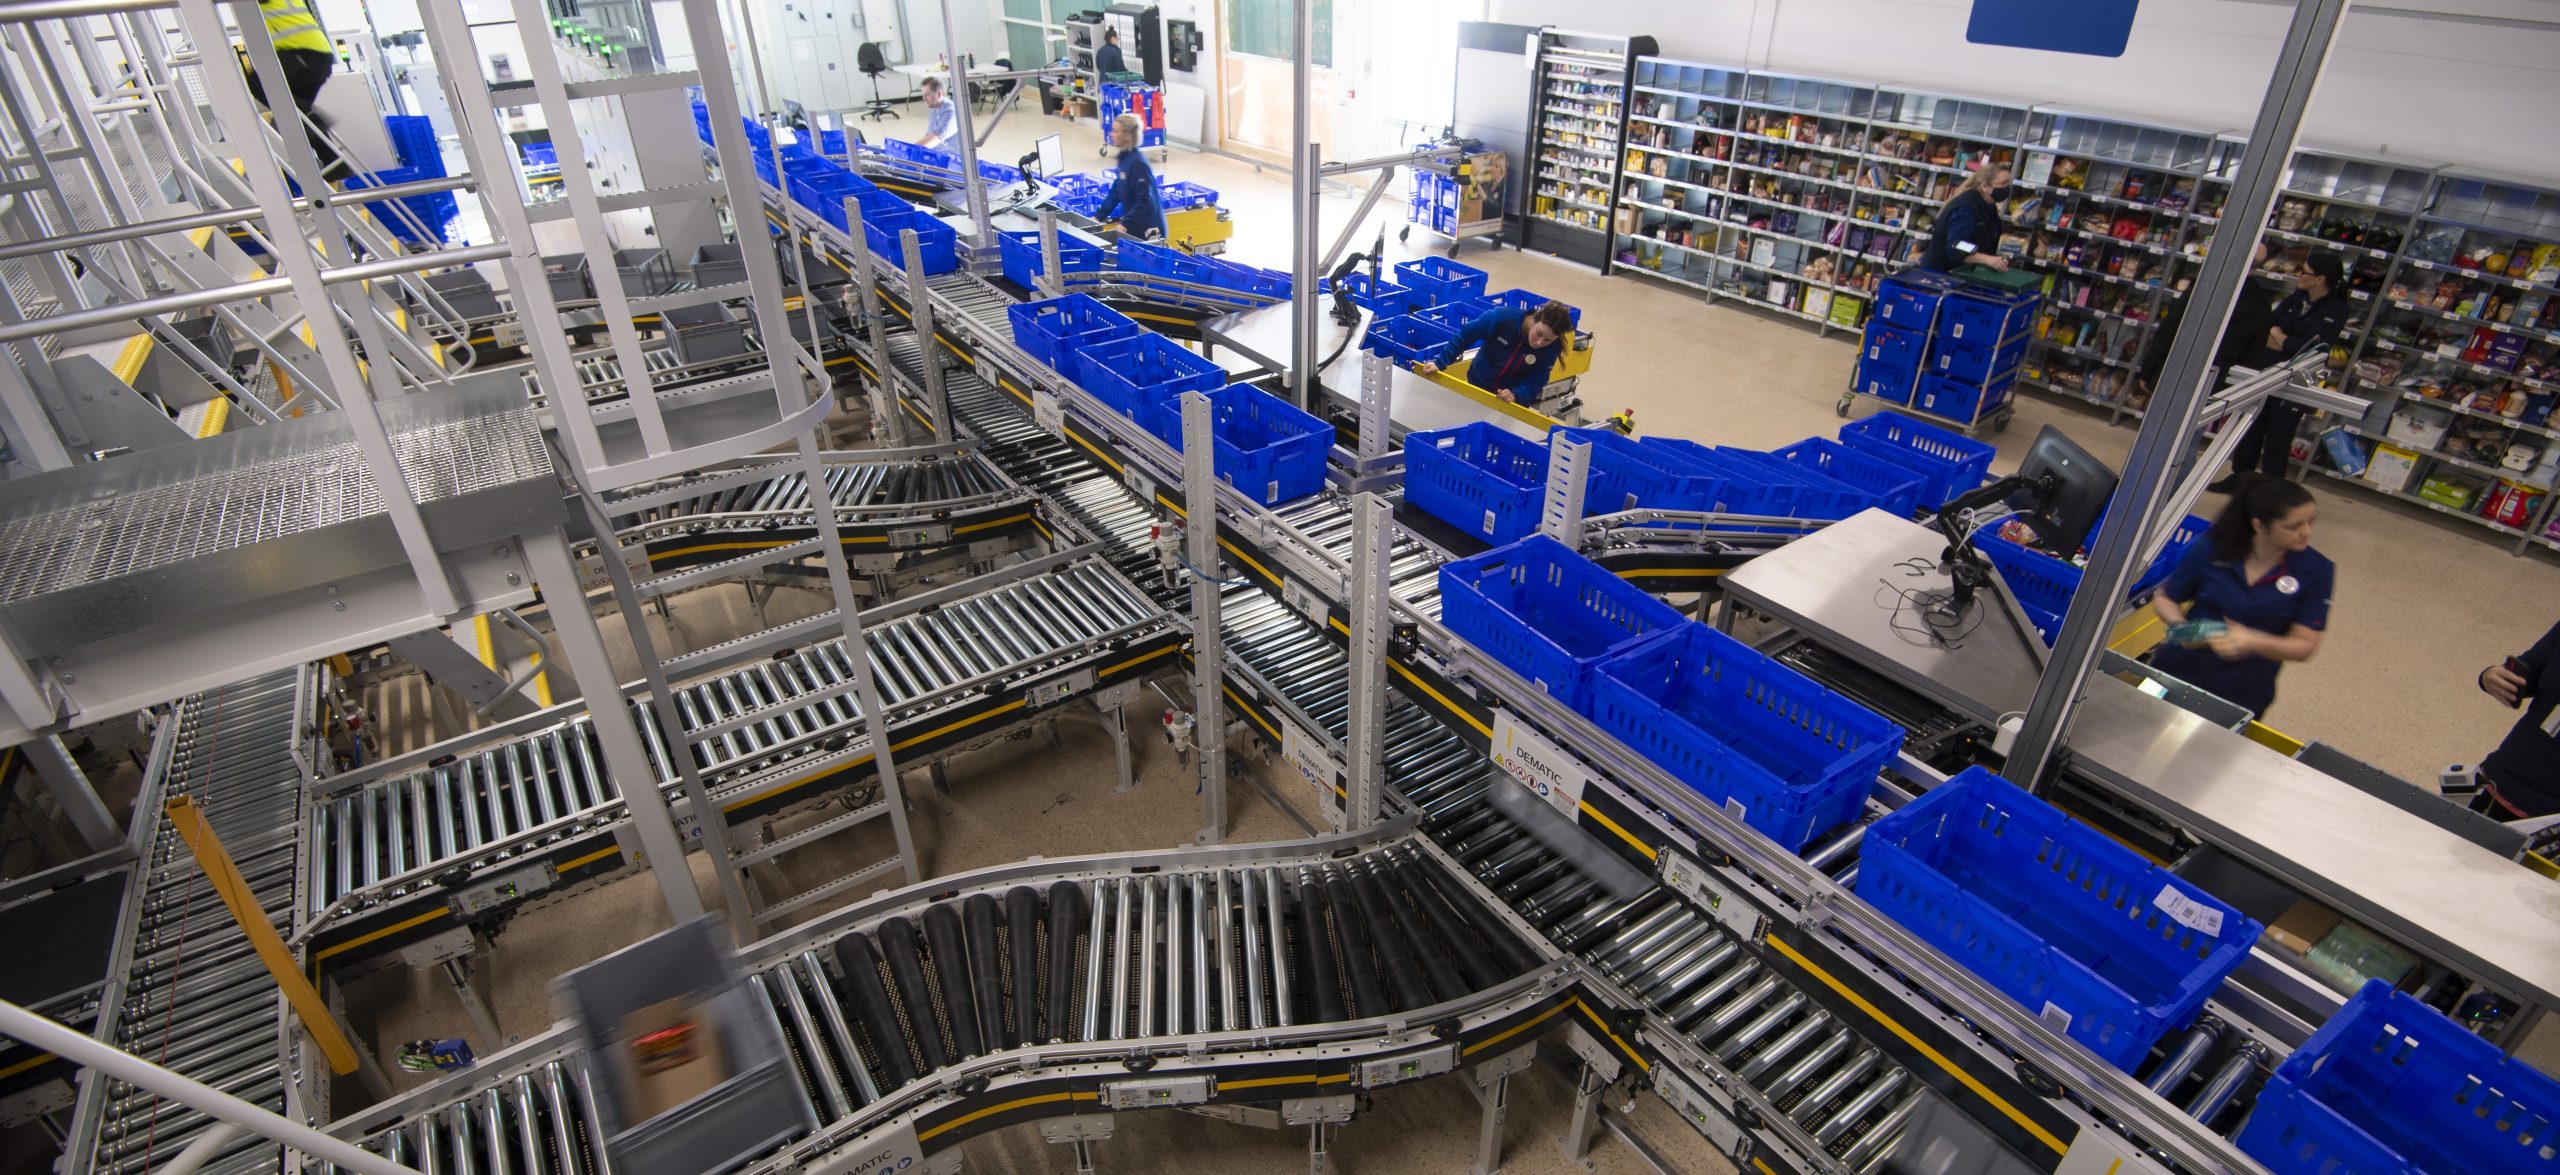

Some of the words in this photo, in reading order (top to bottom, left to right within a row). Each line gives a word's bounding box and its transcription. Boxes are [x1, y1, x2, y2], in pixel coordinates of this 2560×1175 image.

[1298, 749, 1326, 778] DEMATIC
[1516, 746, 1562, 786] DEMATIC
[843, 1149, 894, 1175] MATIC
